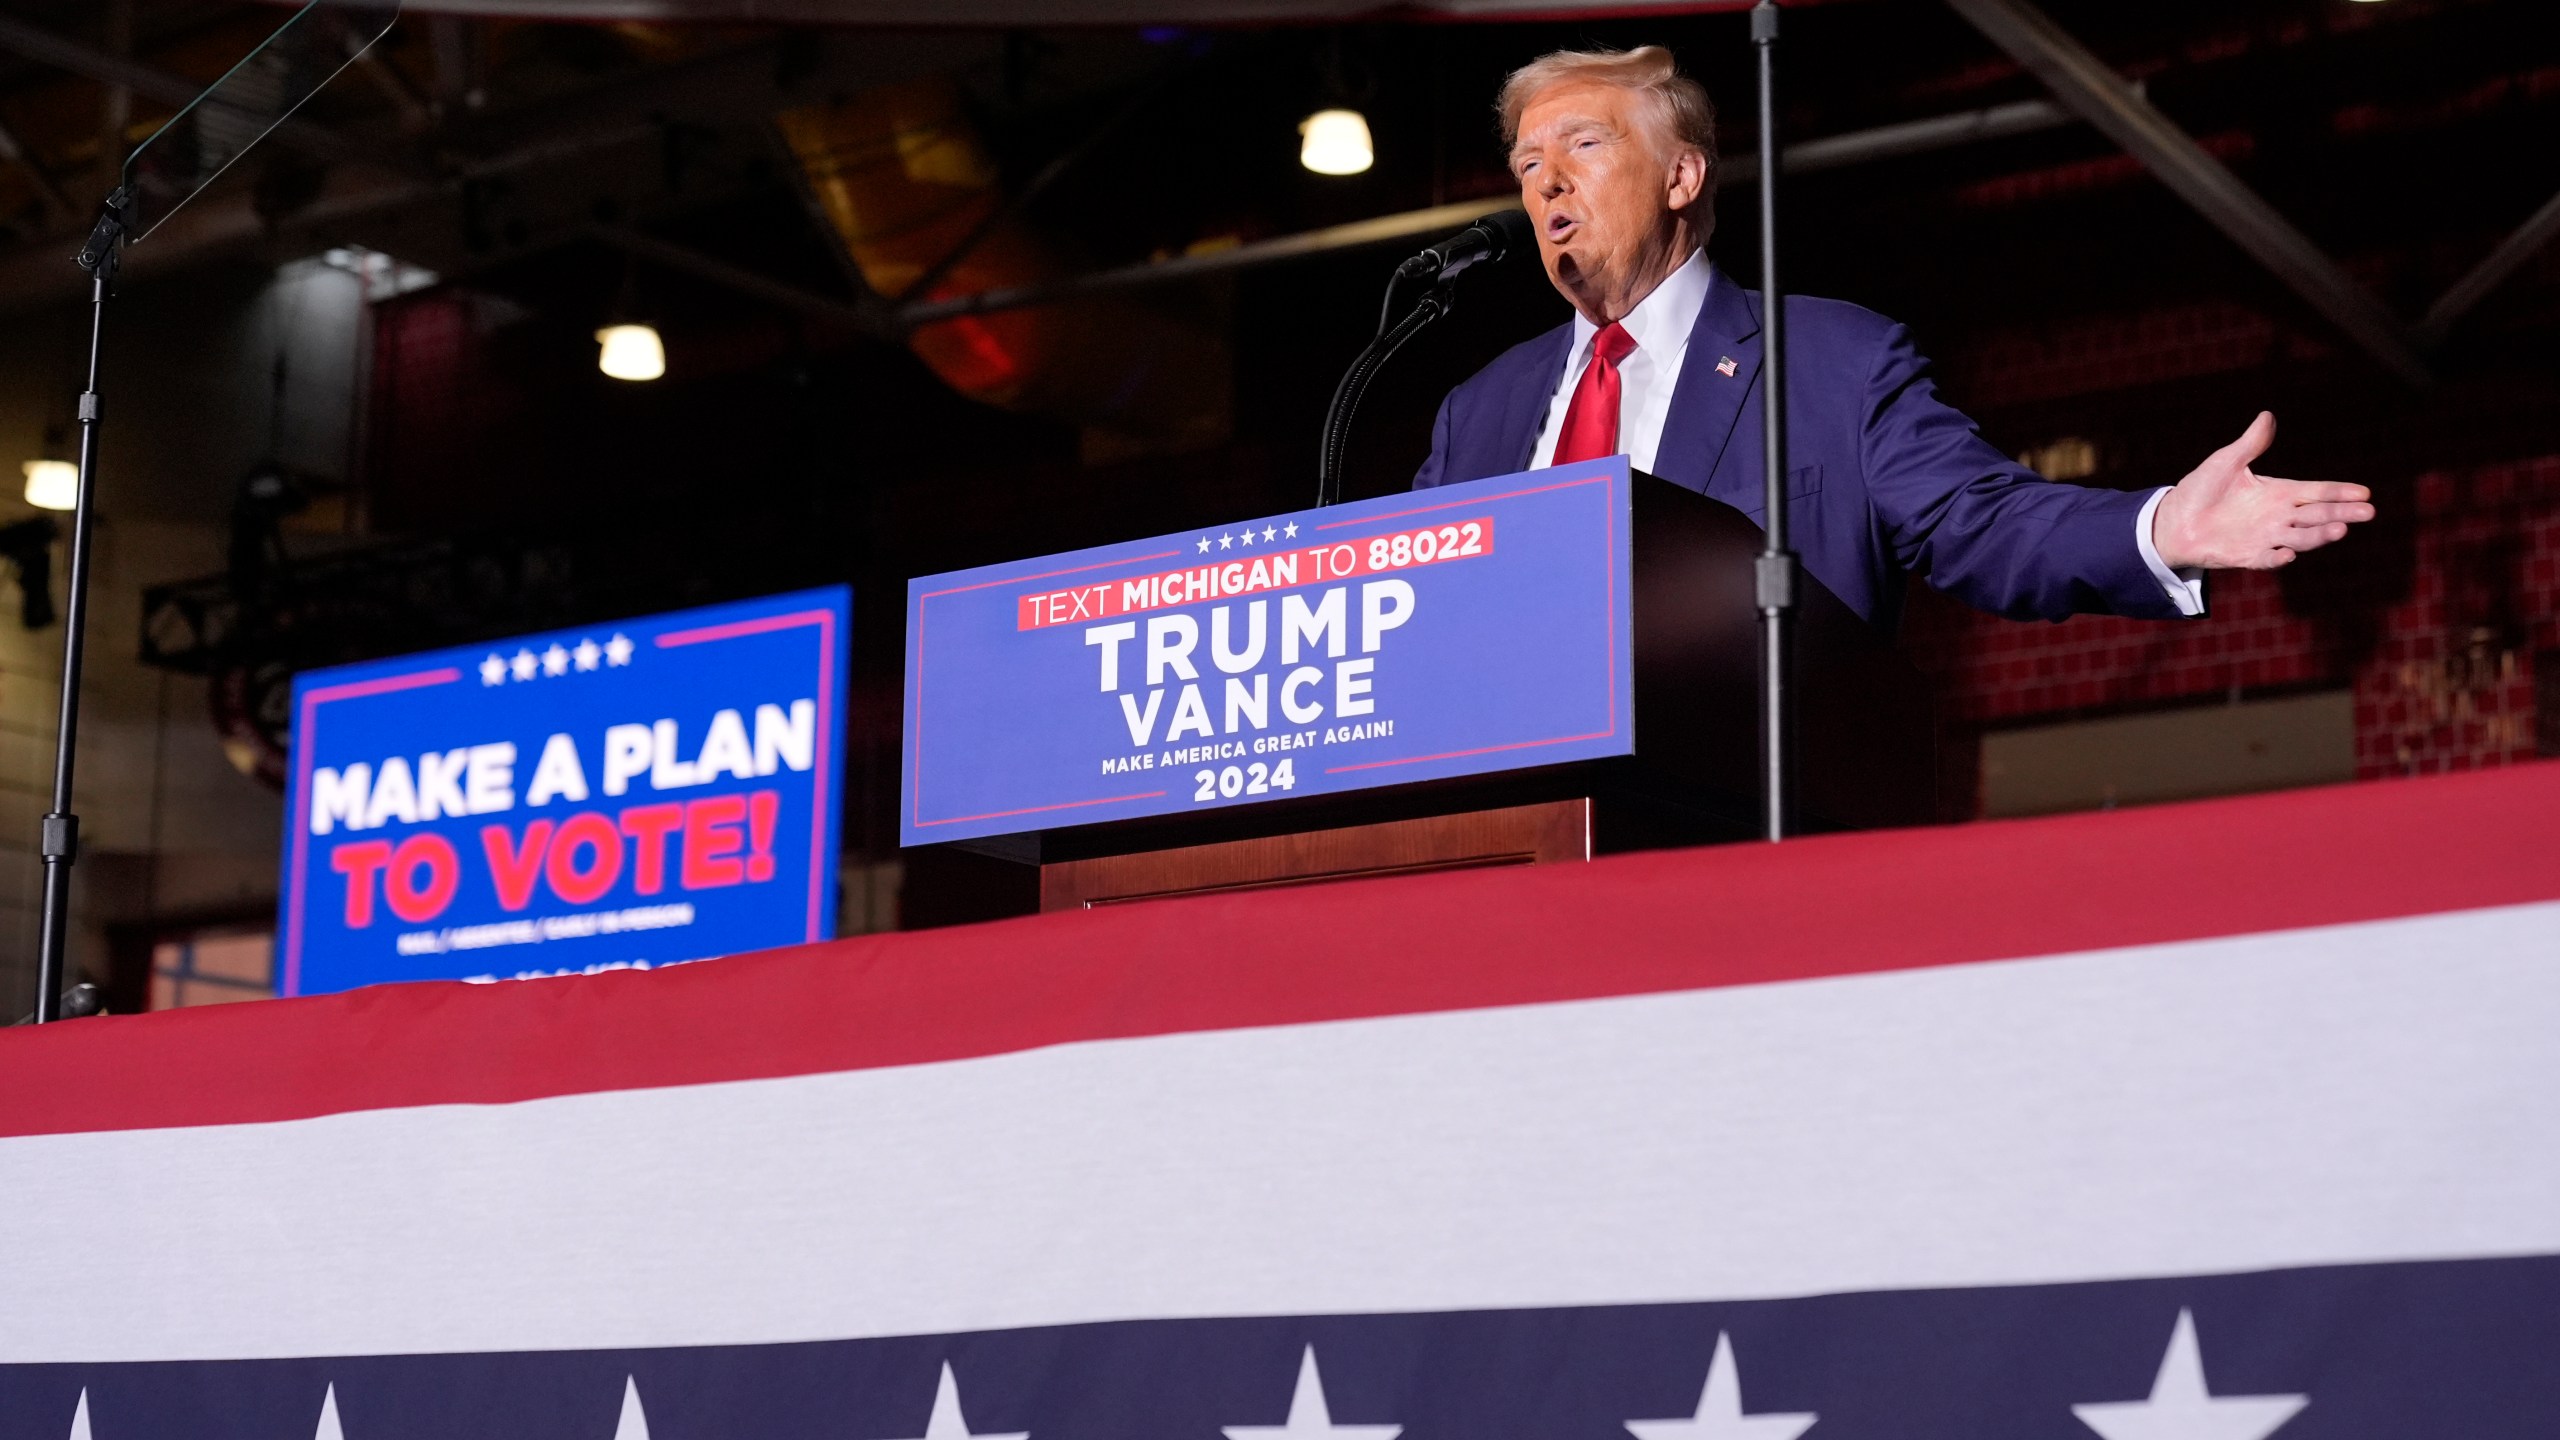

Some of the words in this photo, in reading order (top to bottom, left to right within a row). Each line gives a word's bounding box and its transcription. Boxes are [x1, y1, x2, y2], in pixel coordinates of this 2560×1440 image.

[1028, 584, 1112, 627] TEXT
[1122, 553, 1298, 612] MICHIGAN
[1308, 544, 1357, 580] TO
[1367, 523, 1482, 571] 88022
[1085, 578, 1416, 693] TRUMP
[1102, 751, 1154, 775] MAKE
[1160, 740, 1247, 768] AMERICA
[1253, 730, 1318, 754] GREAT
[1323, 719, 1394, 746] AGAIN!
[1118, 657, 1375, 745] VANCE
[312, 739, 516, 836] MAKE
[526, 733, 588, 806] A
[603, 698, 816, 796] PLAN
[1194, 758, 1295, 802] 2024
[332, 834, 459, 929] TO
[482, 791, 779, 911] VOTE!
